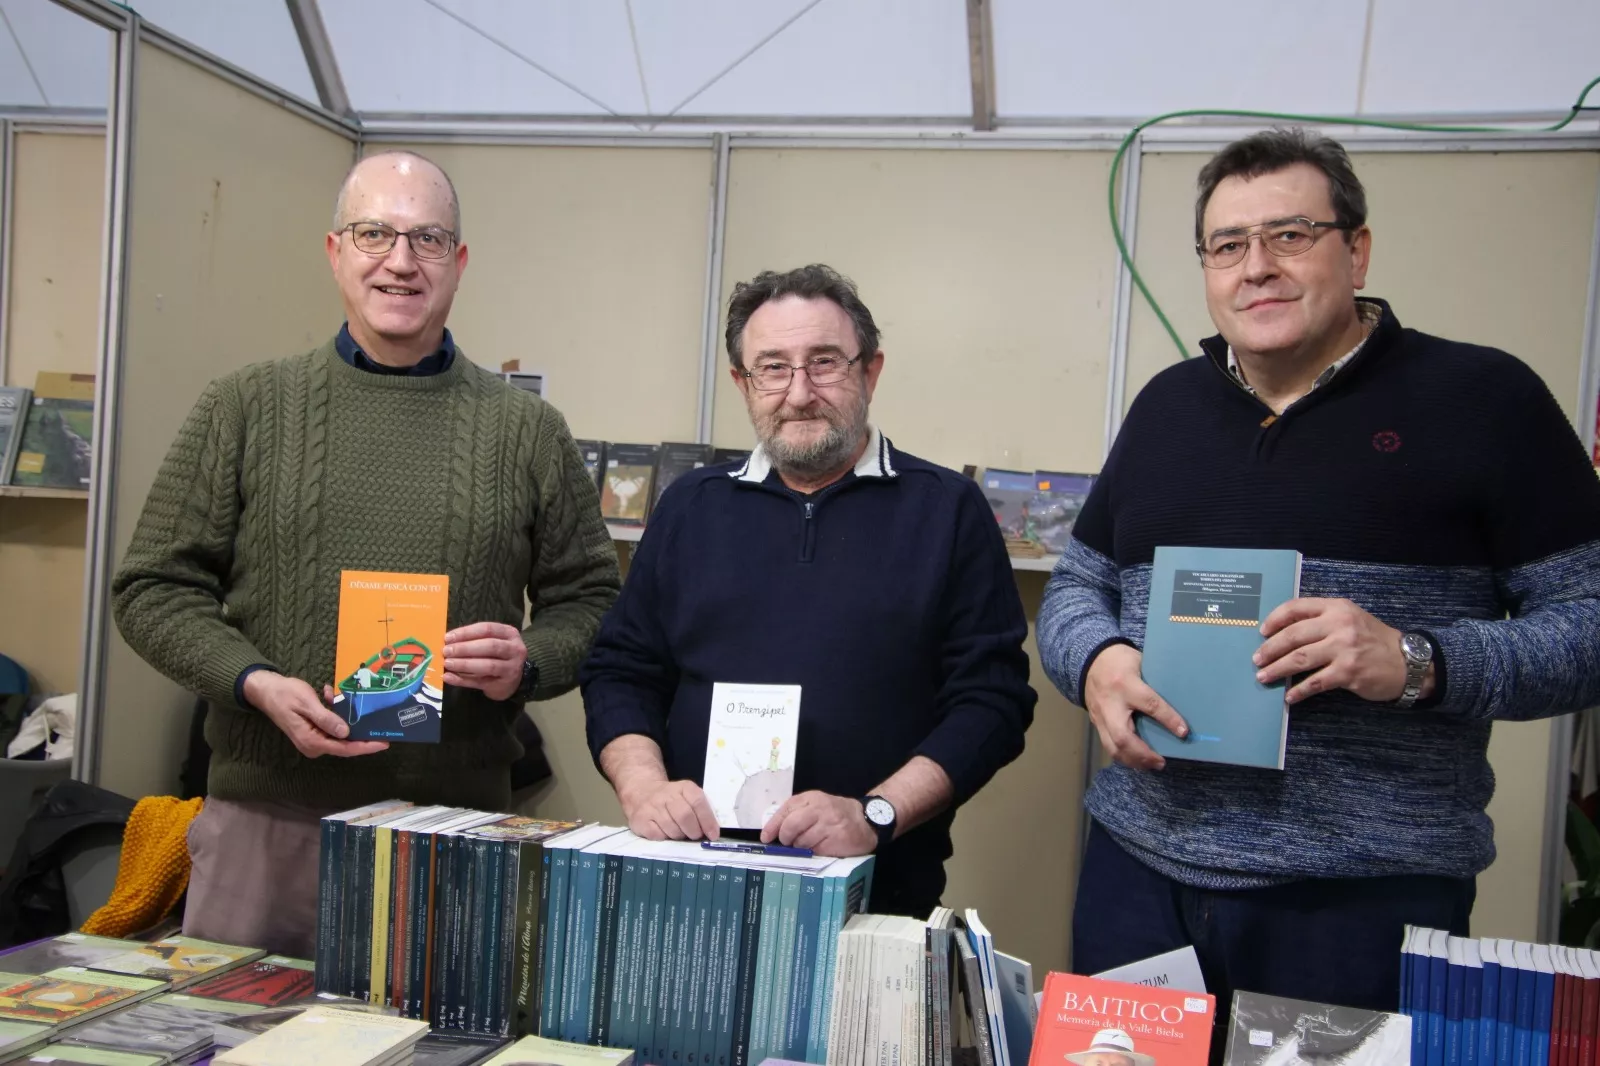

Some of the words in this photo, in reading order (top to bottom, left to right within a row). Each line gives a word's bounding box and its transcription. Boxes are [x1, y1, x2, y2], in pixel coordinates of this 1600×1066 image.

[409, 584, 427, 592] CON
[727, 703, 734, 713] O
[582, 861, 591, 869] 25
[626, 865, 634, 873] 29
[641, 866, 649, 875] 29
[656, 868, 664, 876] 29
[671, 870, 680, 878] 29
[686, 872, 695, 880] 29
[702, 873, 711, 881] 29
[718, 874, 727, 882] 29
[734, 876, 742, 884] 29
[806, 885, 815, 894] 25
[1063, 992, 1183, 1024] BAITICO
[1056, 1013, 1100, 1027] Memoria
[1103, 1019, 1115, 1028] de
[1117, 1020, 1125, 1030] la
[1129, 1022, 1152, 1034] Valle
[1156, 1025, 1183, 1039] Bielsa
